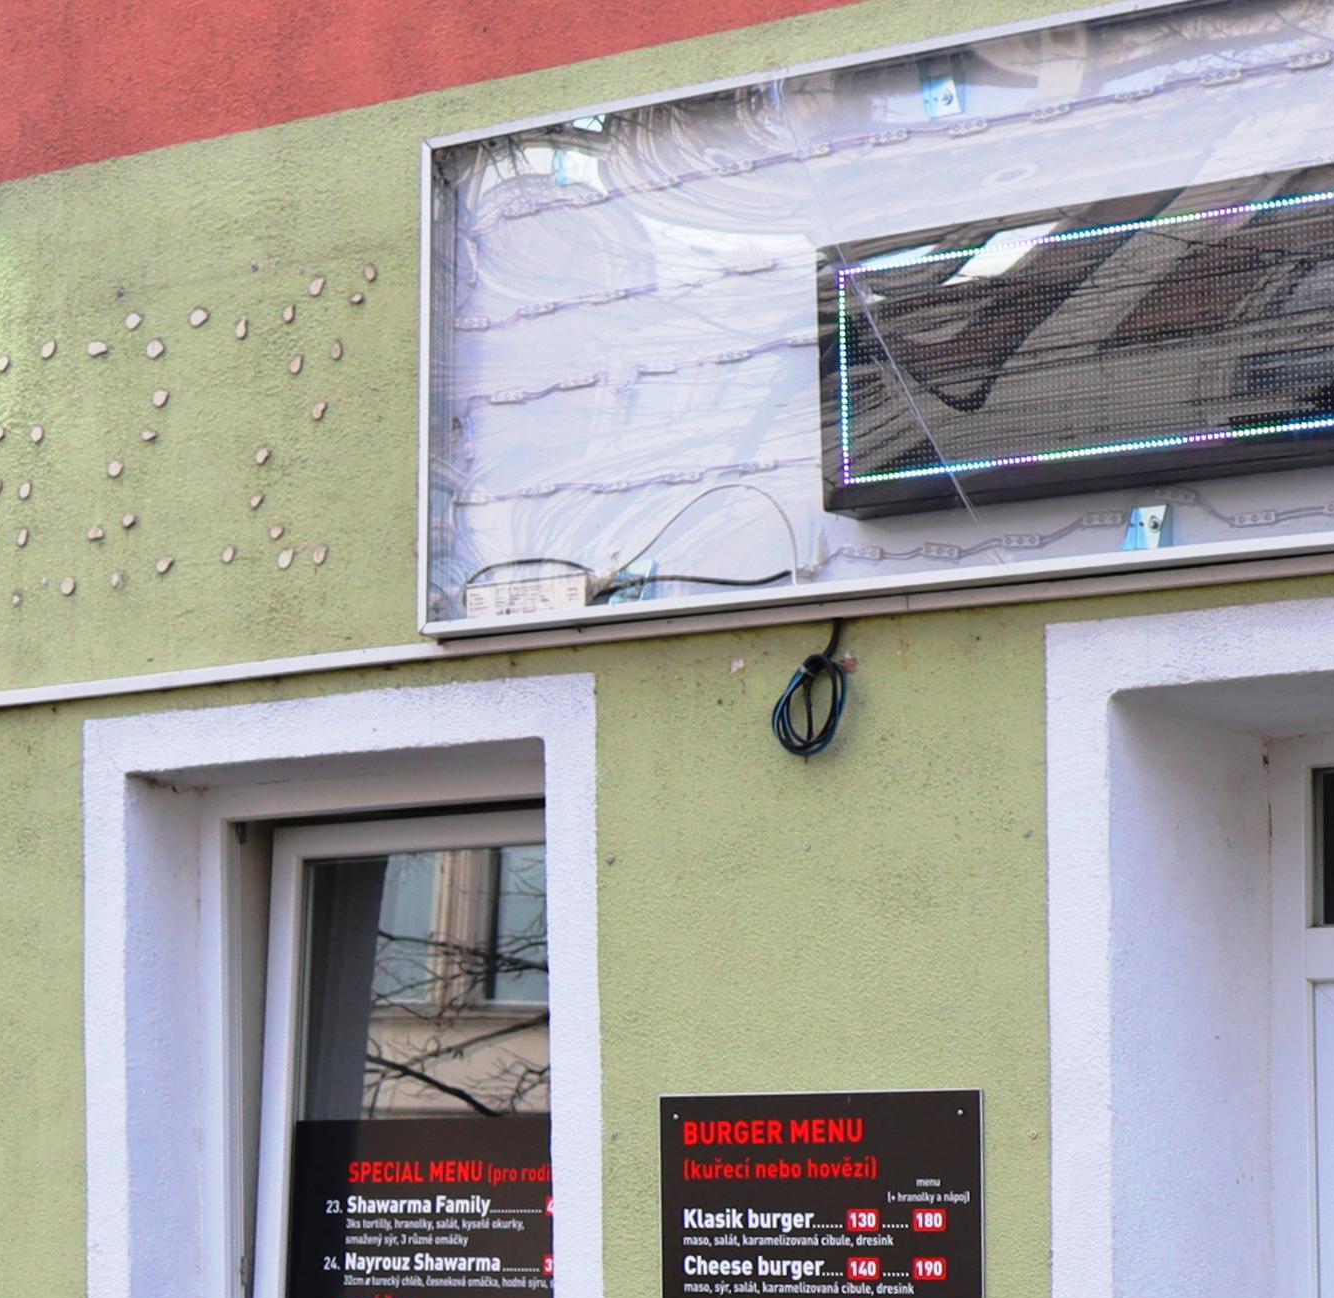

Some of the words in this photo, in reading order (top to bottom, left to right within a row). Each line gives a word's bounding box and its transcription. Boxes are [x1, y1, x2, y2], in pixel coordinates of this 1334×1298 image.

[683, 1120, 783, 1145] BURGER
[790, 1118, 864, 1143] MENU
[348, 1161, 423, 1183] SPECIAL
[430, 1160, 483, 1182] MENU
[488, 1162, 517, 1186] (pro
[683, 1157, 750, 1180] (kuřecí
[756, 1158, 802, 1179] nebo
[807, 1156, 878, 1179] hovězí)
[916, 1178, 941, 1188] menu
[326, 1200, 343, 1214] 23.
[347, 1195, 431, 1213] Shawarma
[436, 1195, 491, 1217] Family
[897, 1191, 935, 1205] hranolky
[944, 1191, 971, 1205] nápoj)
[394, 1218, 434, 1231] hranolky,
[436, 1218, 459, 1230] salát,
[462, 1219, 490, 1231] kyselé
[492, 1219, 524, 1232] okurky,
[683, 1208, 743, 1229] Klasik
[849, 1212, 876, 1228] 130
[916, 1212, 943, 1228] 180
[345, 1233, 382, 1246] smažený
[384, 1234, 398, 1246] sýr,
[408, 1233, 433, 1245] různé
[435, 1234, 468, 1247] omáčky
[683, 1235, 712, 1247] maso,
[714, 1233, 740, 1247] salát,
[742, 1234, 819, 1247] karamelizovaná
[821, 1234, 854, 1248] cibule,
[856, 1234, 895, 1247] dresink
[324, 1256, 340, 1271] 24.
[345, 1252, 410, 1274] Nayrouz
[414, 1253, 501, 1272] Shawarma
[683, 1255, 753, 1277] Cheese
[850, 1261, 876, 1277] 140
[916, 1260, 943, 1277] 190
[683, 1283, 713, 1294] maso,
[715, 1281, 731, 1296] sýr,
[733, 1280, 760, 1295] salát,
[762, 1281, 839, 1294] karamelizovaná
[841, 1282, 874, 1296] cibule,
[876, 1282, 915, 1295] dresink
